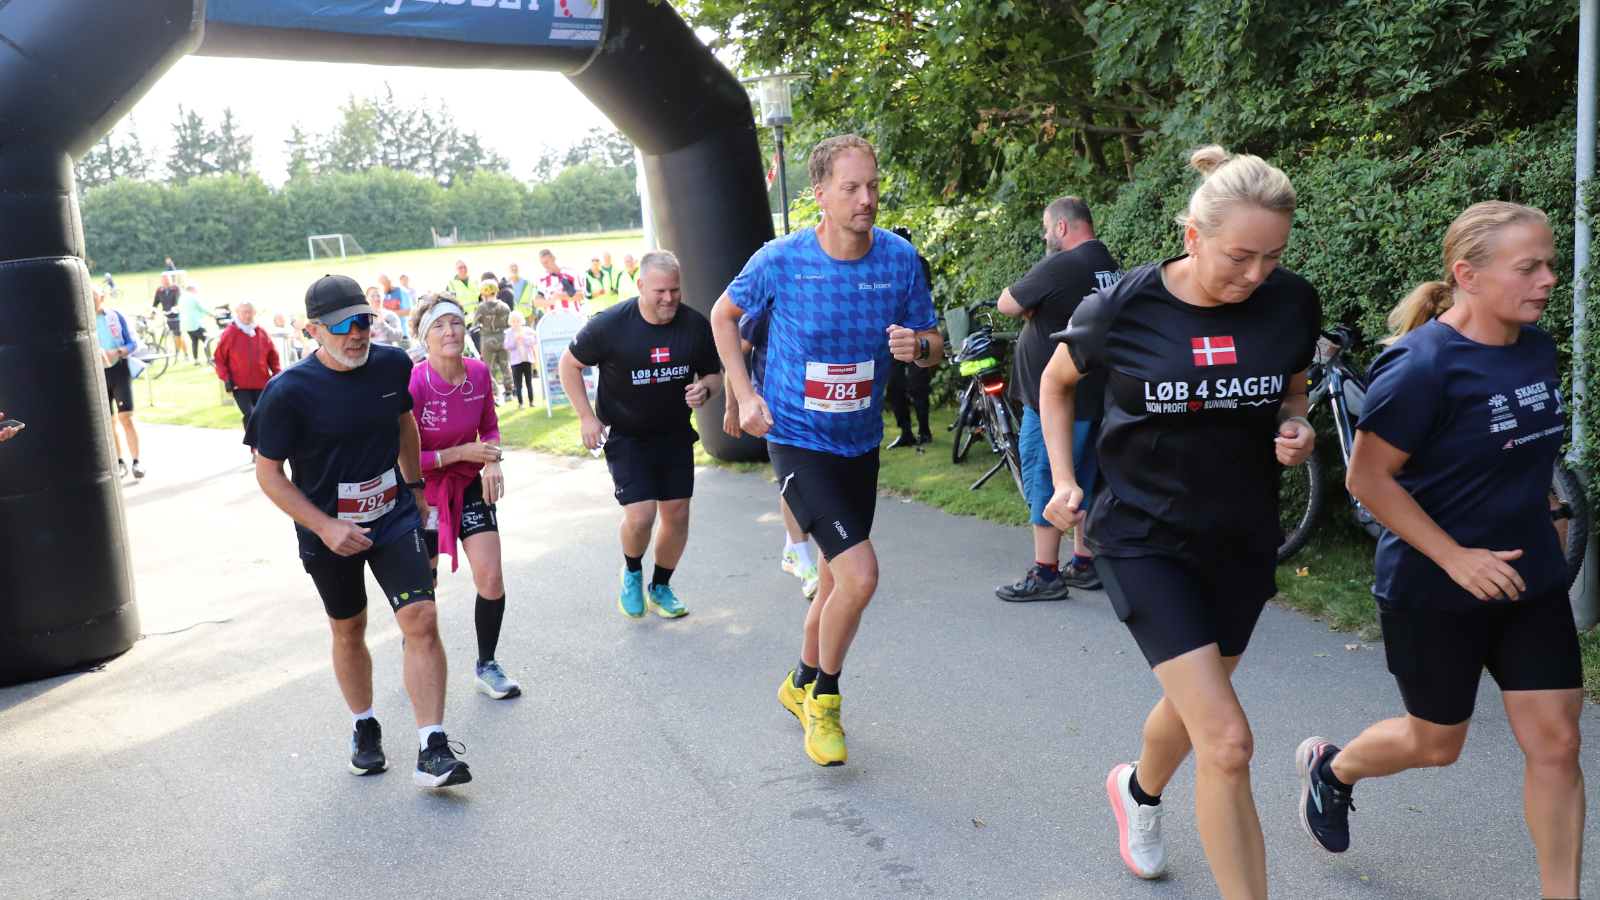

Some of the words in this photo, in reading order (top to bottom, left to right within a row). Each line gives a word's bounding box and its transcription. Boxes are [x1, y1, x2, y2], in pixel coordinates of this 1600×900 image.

[872, 282, 892, 291] Jensen
[631, 368, 651, 380] LØB
[652, 368, 659, 377] 4
[660, 364, 690, 377] SAGEN
[823, 383, 857, 400] 784
[1144, 381, 1189, 401] LØB
[1195, 379, 1209, 399] 4
[1215, 374, 1284, 398] SAGEN
[1515, 382, 1547, 399] SKAGEN
[1145, 402, 1162, 414] NON
[1163, 402, 1188, 413] PROFIT
[1204, 398, 1238, 410] RUNNING
[1518, 392, 1550, 407] MARATHON
[357, 492, 385, 513] 792
[832, 520, 849, 540] FUSION
